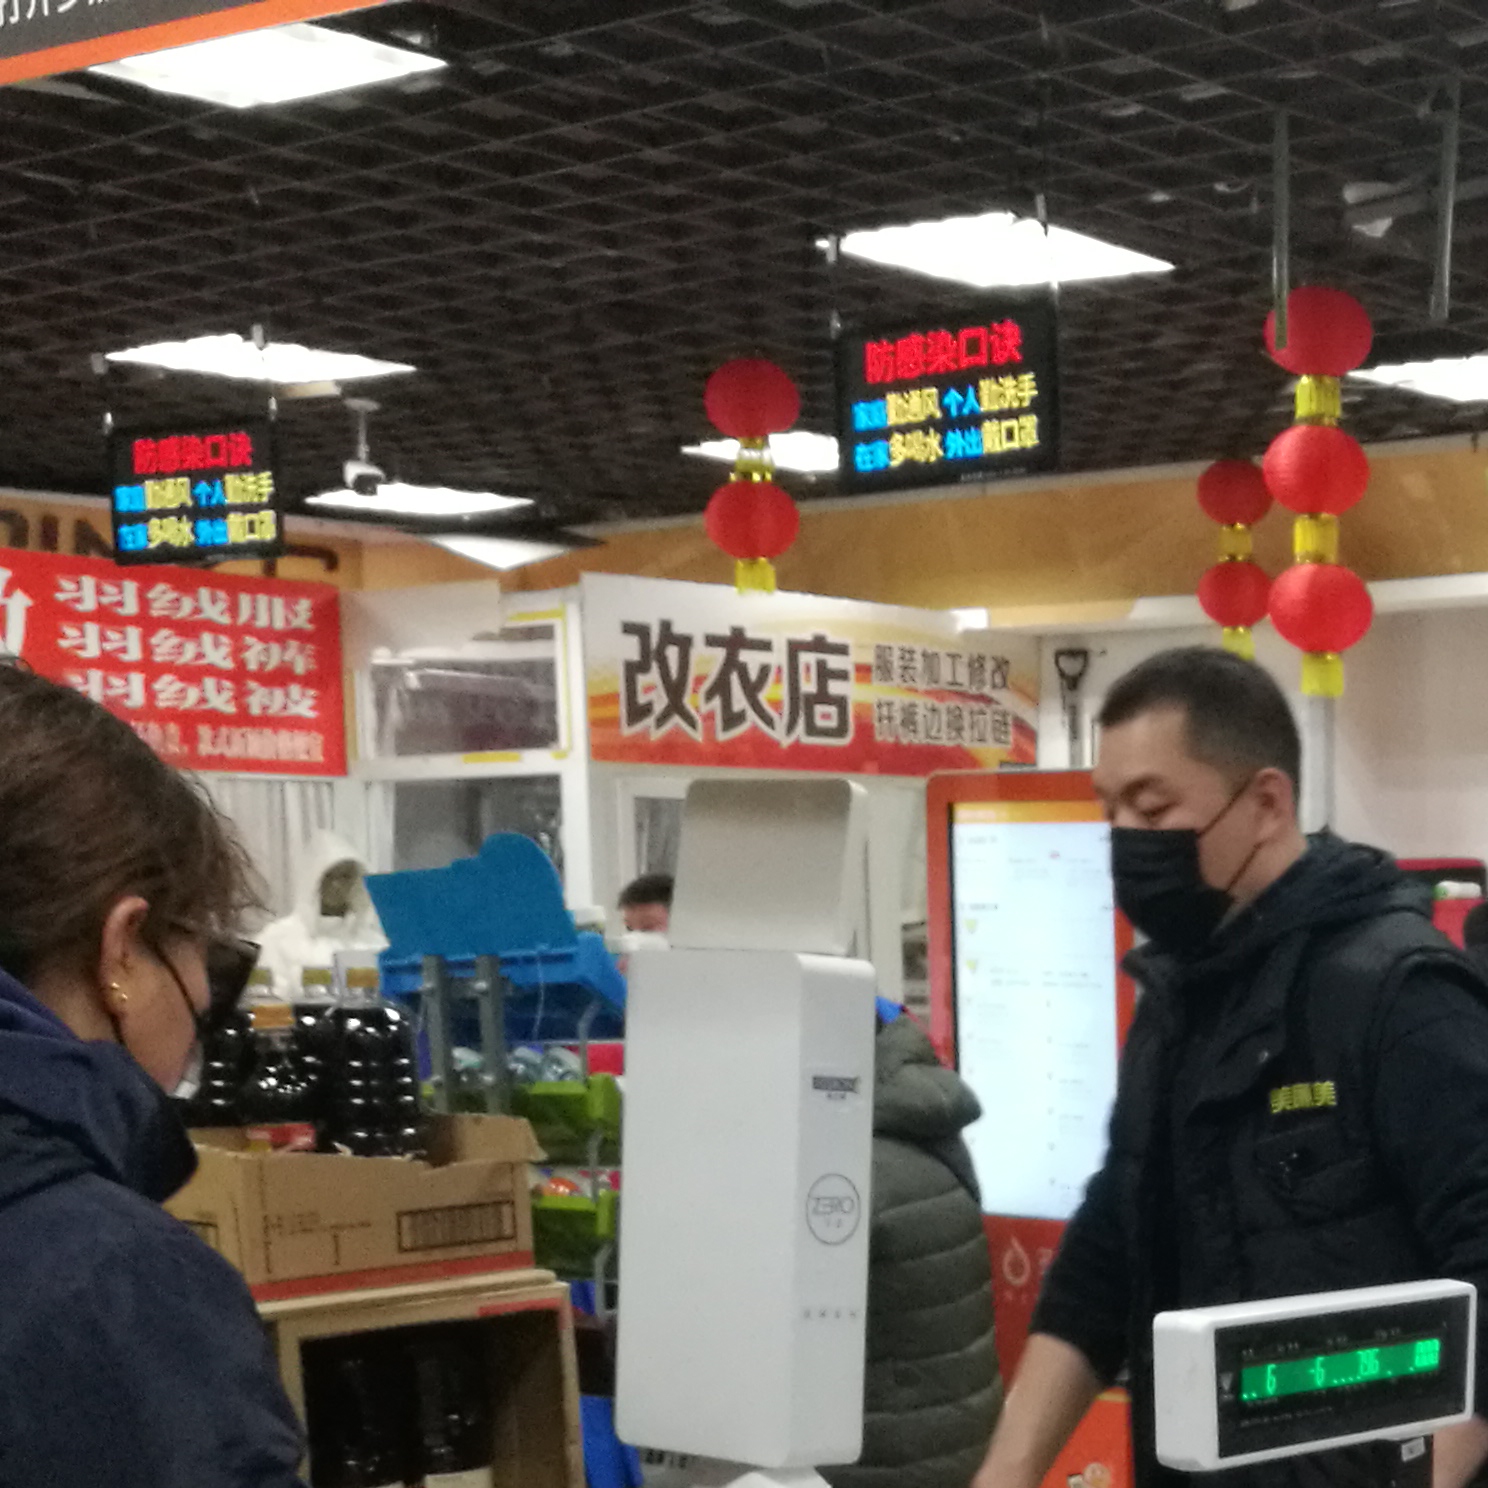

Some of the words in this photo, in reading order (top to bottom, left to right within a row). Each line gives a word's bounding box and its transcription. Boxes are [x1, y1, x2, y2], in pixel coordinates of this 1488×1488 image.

[865, 318, 1023, 384] 防感染口诀
[54, 574, 315, 631] 羽绒服
[620, 617, 852, 740] 改衣店
[872, 643, 1012, 692] 服装加工修改
